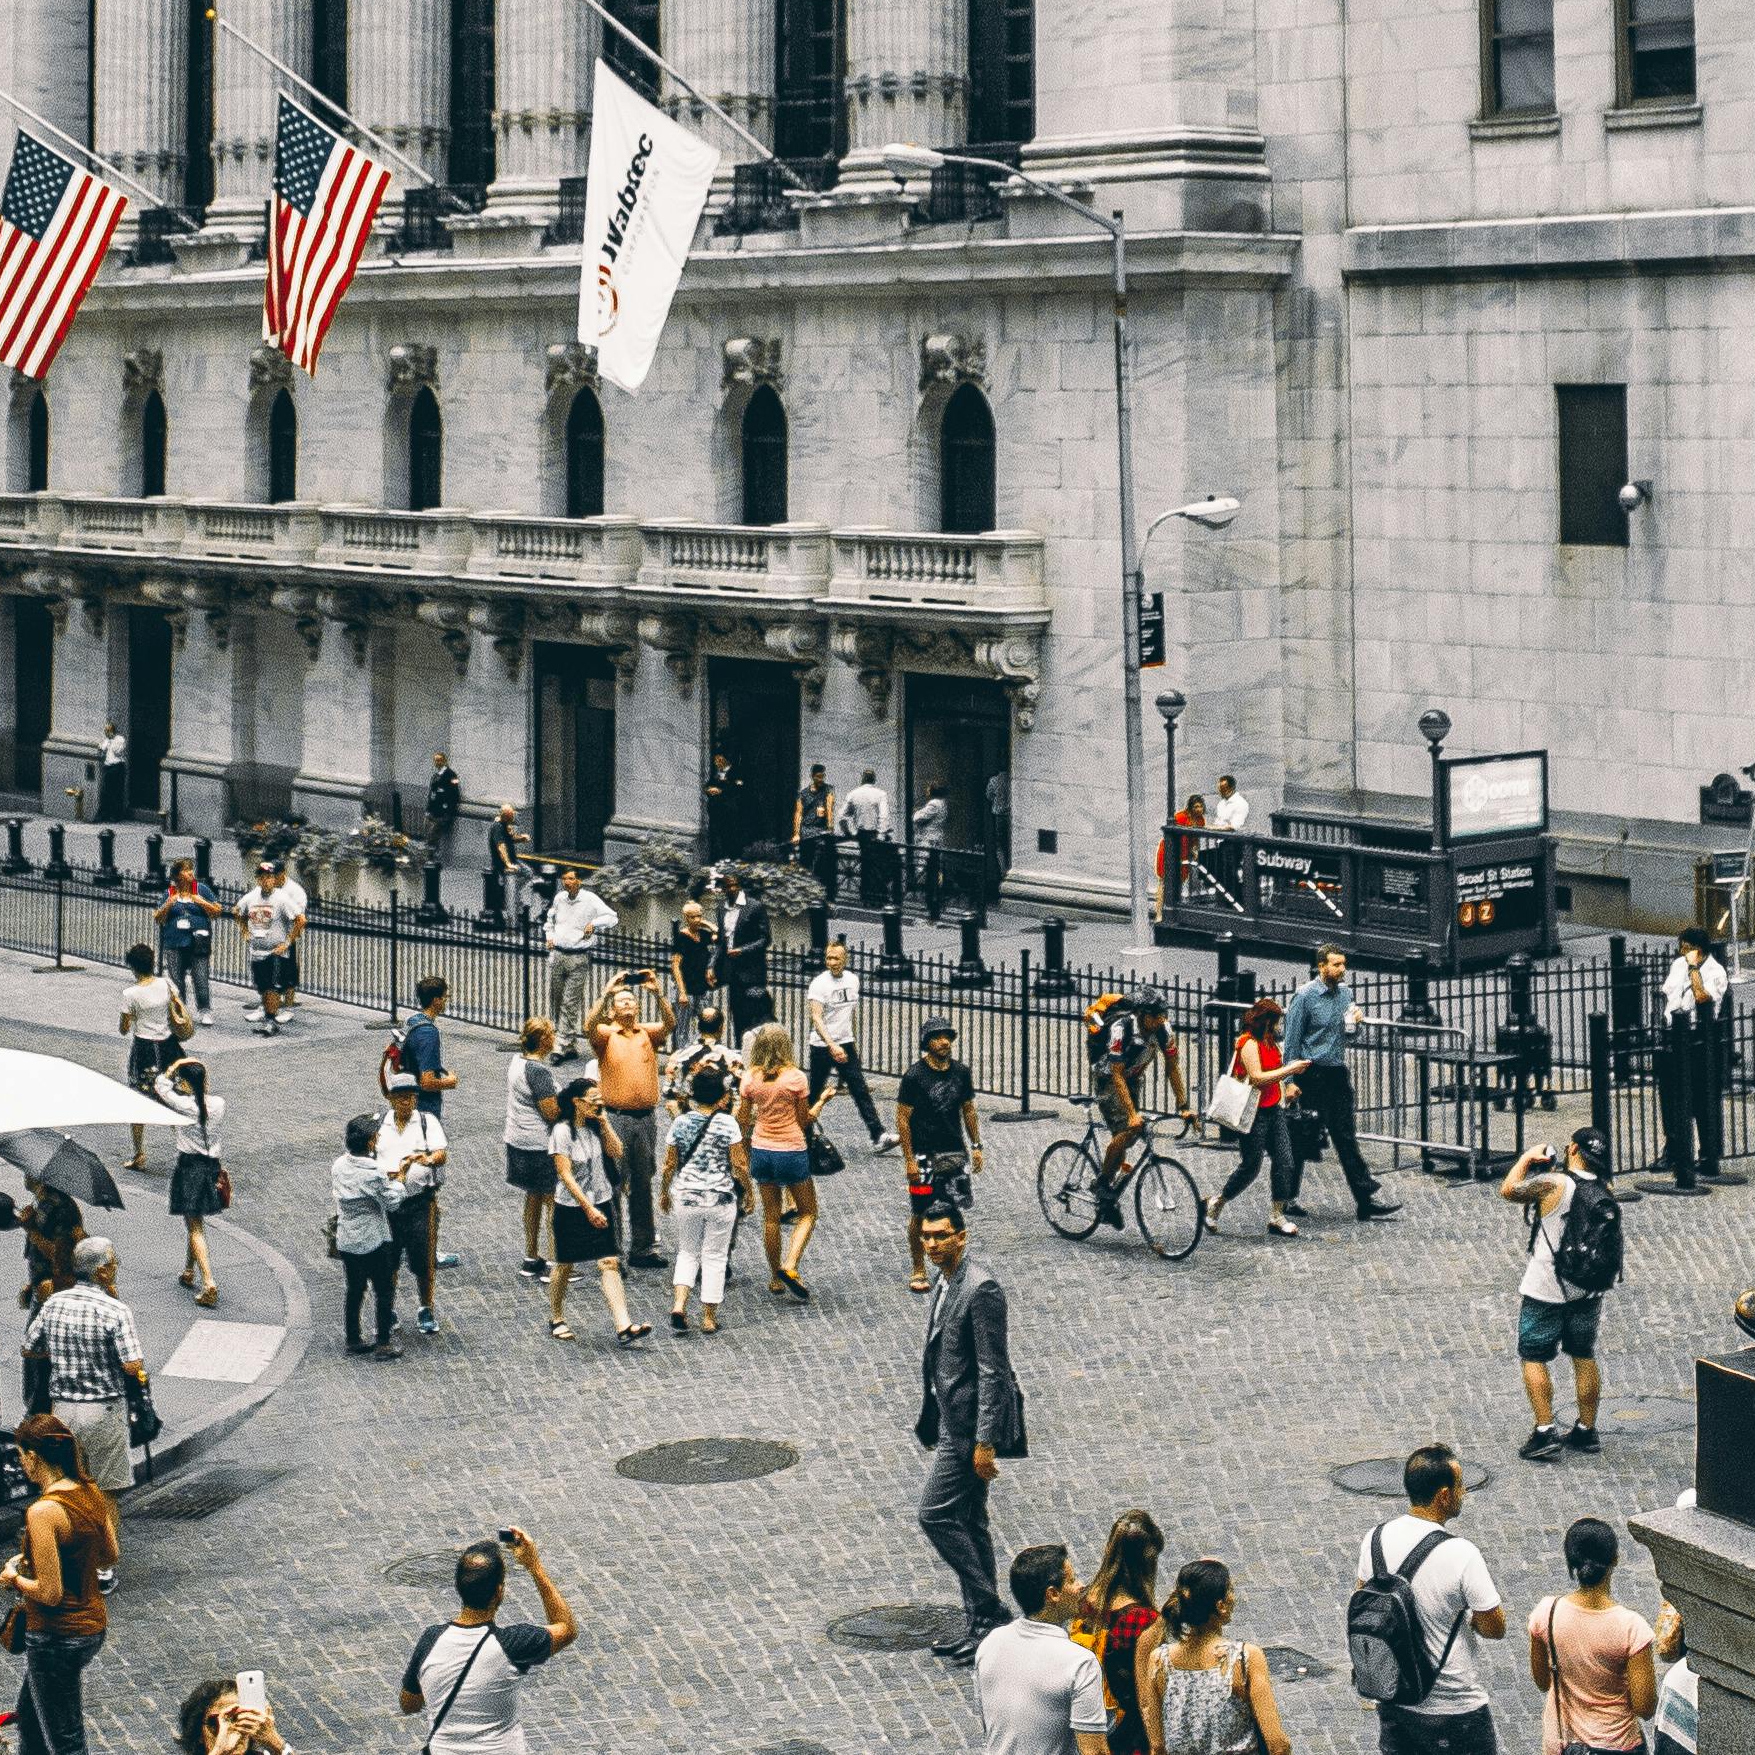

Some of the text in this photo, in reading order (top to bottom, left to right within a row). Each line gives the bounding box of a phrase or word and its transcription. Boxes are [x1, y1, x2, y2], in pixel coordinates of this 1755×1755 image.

[1256, 849, 1312, 874] Subway
[1457, 871, 1485, 887] Broad
[1500, 867, 1533, 881] Station
